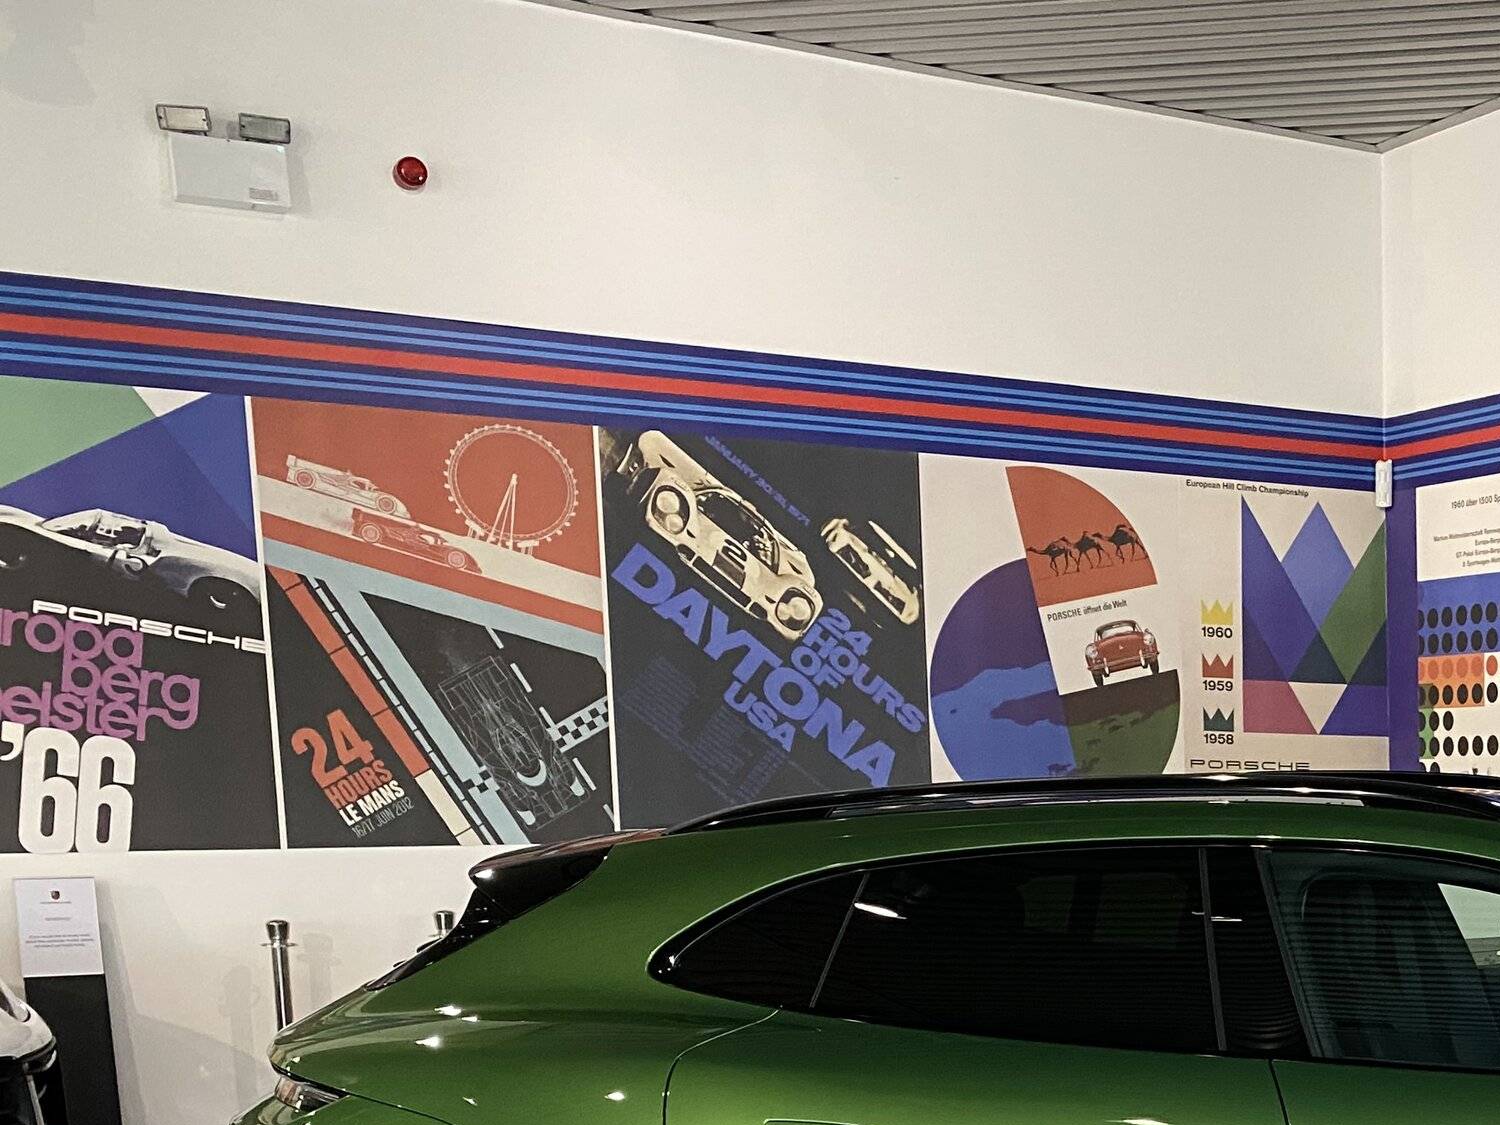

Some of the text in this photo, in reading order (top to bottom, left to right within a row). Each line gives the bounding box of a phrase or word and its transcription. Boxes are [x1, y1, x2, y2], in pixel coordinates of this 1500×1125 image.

[1185, 479, 1309, 498] European Hill Climb Championship
[0, 607, 144, 668] ropa
[32, 599, 267, 654] PORSCHE
[818, 607, 873, 657] 24
[1047, 607, 1082, 622] PORSCHE
[1201, 626, 1233, 639] 1960
[611, 542, 896, 789] DAYTONA
[790, 645, 846, 688] OF
[802, 623, 926, 733] HOURS
[1202, 680, 1233, 692] 1959
[0, 682, 146, 741] eister
[61, 656, 200, 730] berg
[723, 680, 796, 752] USA
[291, 709, 374, 789] 24
[1203, 733, 1235, 745] 1958
[324, 760, 393, 811] HOURS
[1190, 759, 1311, 771] PORSCHE
[339, 779, 405, 827] LE MANS
[375, 806, 396, 828] JUIN
[391, 796, 415, 817] 2012
